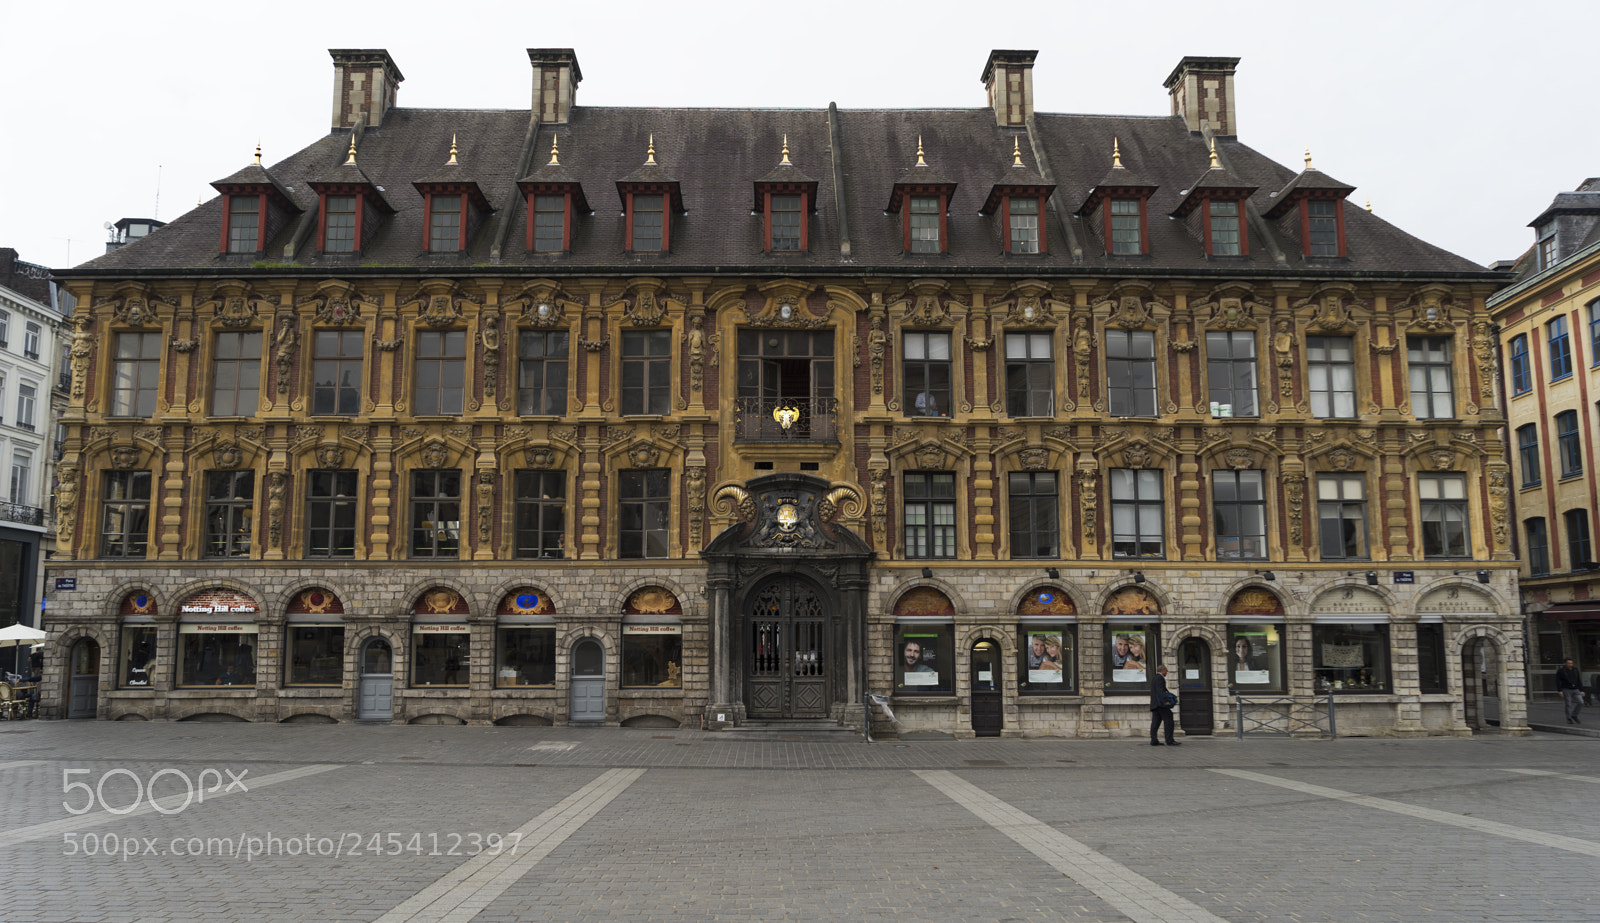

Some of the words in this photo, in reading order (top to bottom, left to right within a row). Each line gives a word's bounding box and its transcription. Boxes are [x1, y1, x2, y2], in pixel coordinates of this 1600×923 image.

[181, 605, 213, 615] Notting
[213, 605, 229, 613] Hill
[230, 605, 256, 613] coffee
